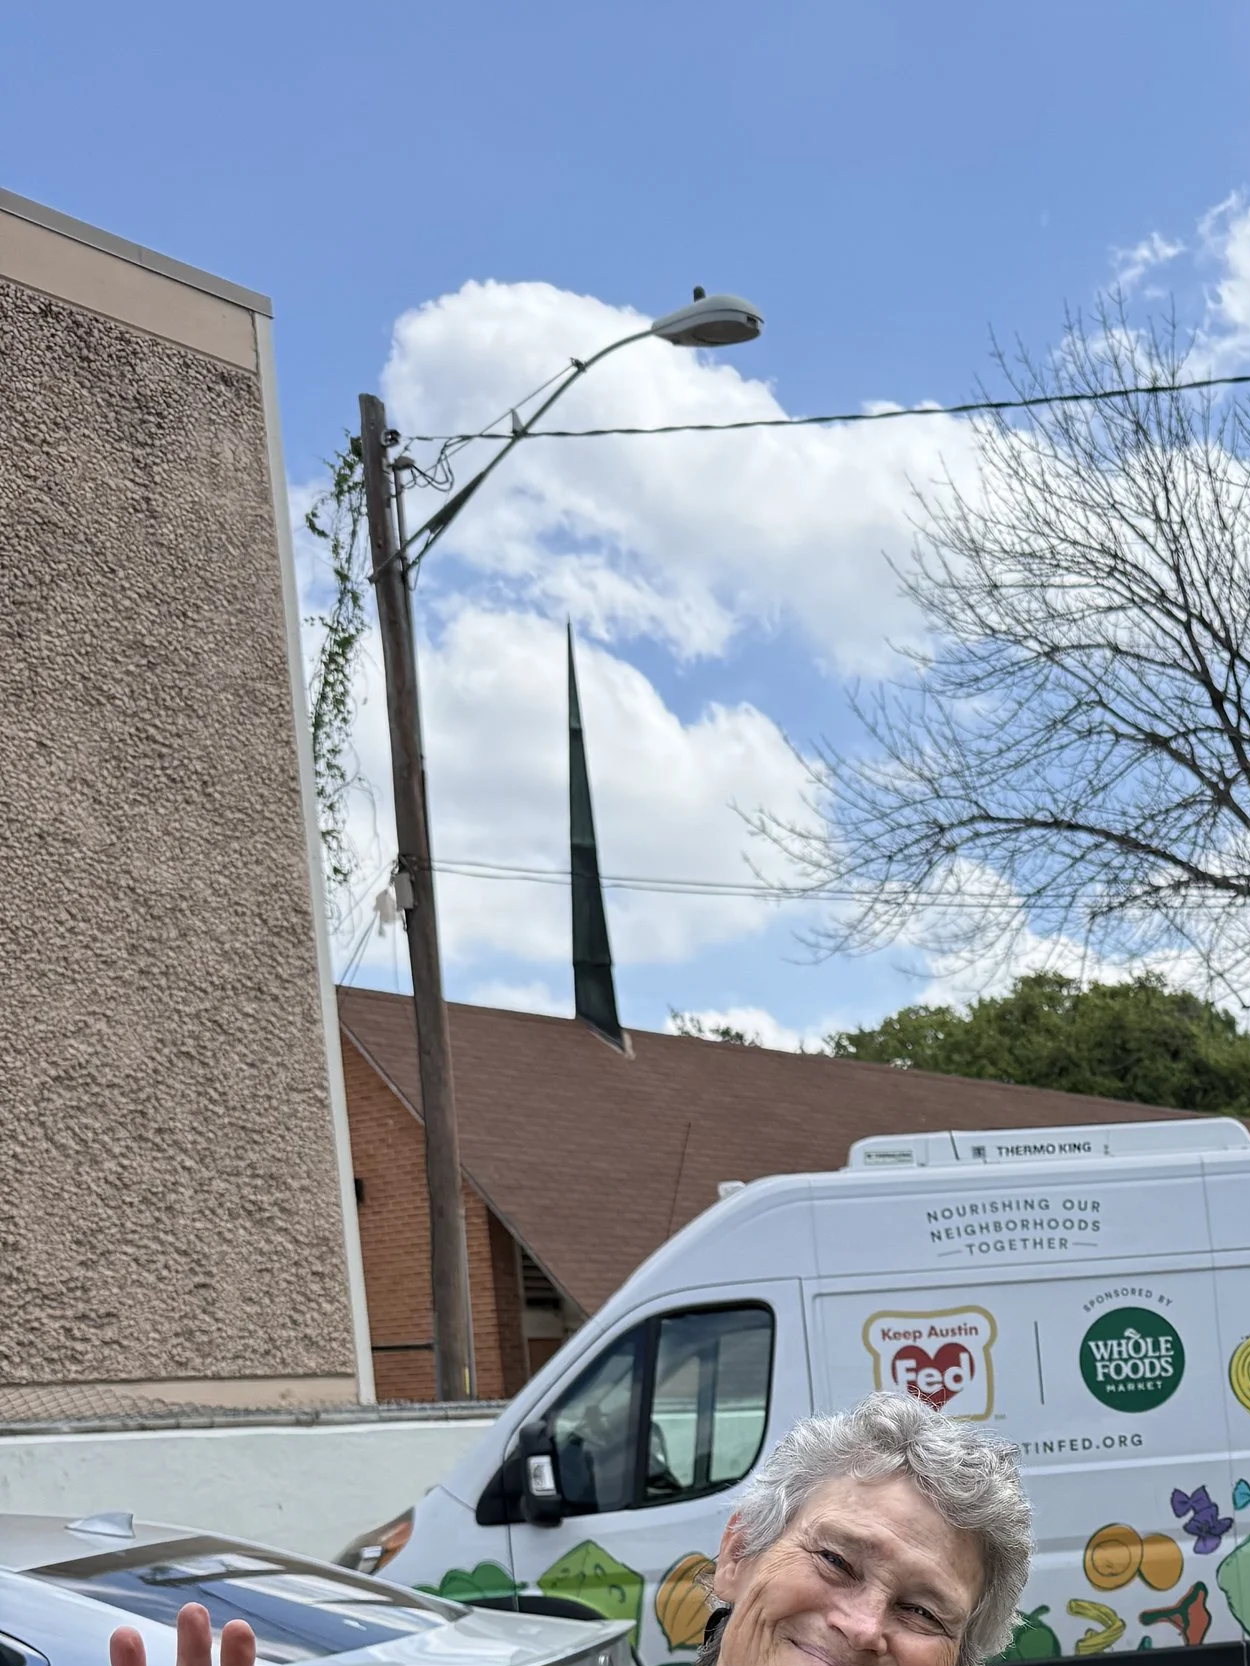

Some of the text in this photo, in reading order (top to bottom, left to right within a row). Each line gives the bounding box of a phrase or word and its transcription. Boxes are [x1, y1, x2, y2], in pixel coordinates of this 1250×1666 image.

[997, 1142, 1092, 1157] THERMO KING
[926, 1199, 1100, 1222] NOURISHING OUR
[930, 1219, 1101, 1242] NEIGHBORHOODS
[965, 1237, 1069, 1255] TOGETHER
[1082, 1288, 1174, 1312] SPONSORED BY
[881, 1323, 979, 1343] Keep Austin
[1087, 1333, 1175, 1360] WHOLE
[895, 1352, 971, 1392] Fed
[1095, 1358, 1174, 1382] FOODS
[1105, 1381, 1164, 1393] MARKET
[1016, 1433, 1143, 1456] TINFED.ORG
